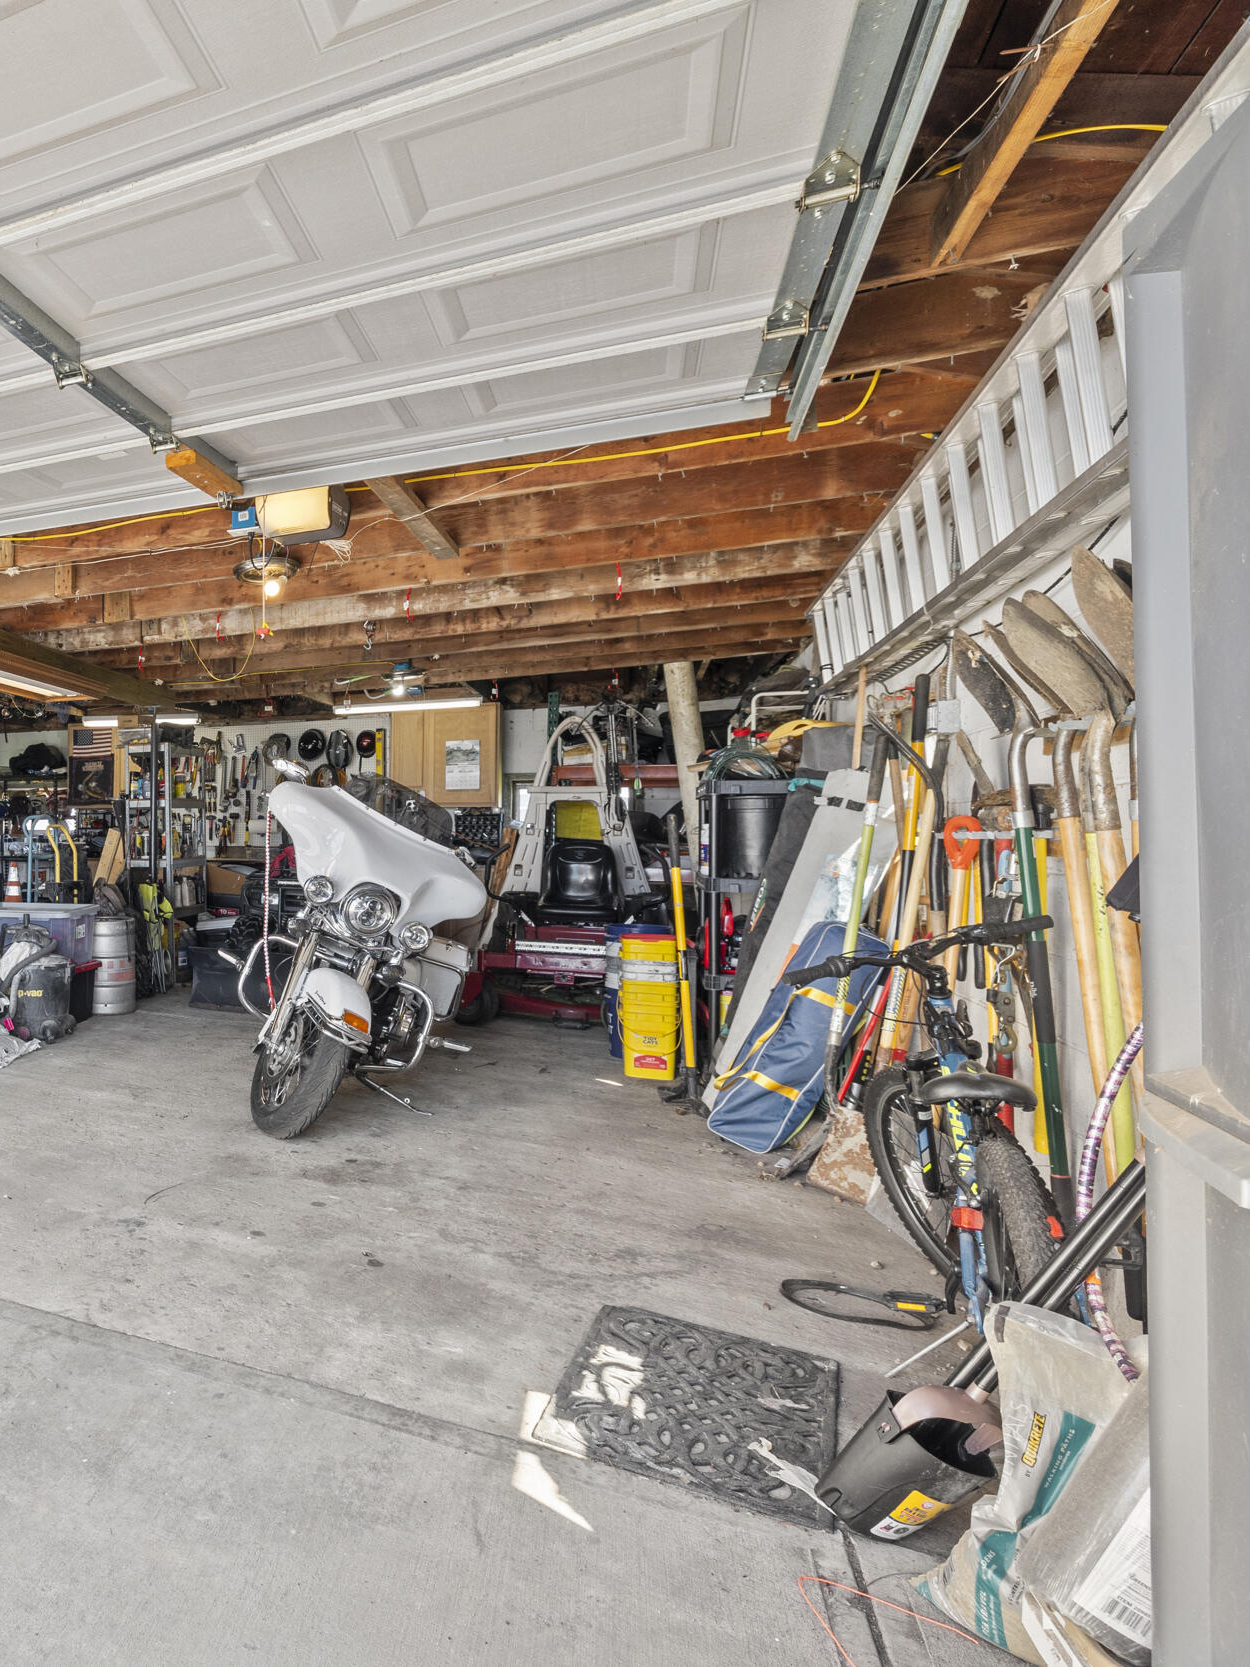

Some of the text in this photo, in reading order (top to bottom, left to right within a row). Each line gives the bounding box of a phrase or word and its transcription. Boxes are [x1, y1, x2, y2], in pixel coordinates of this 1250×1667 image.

[1021, 1411, 1047, 1468] QUIKRETE
[1044, 1454, 1064, 1489] WALKING
[1060, 1428, 1076, 1453] PATHS
